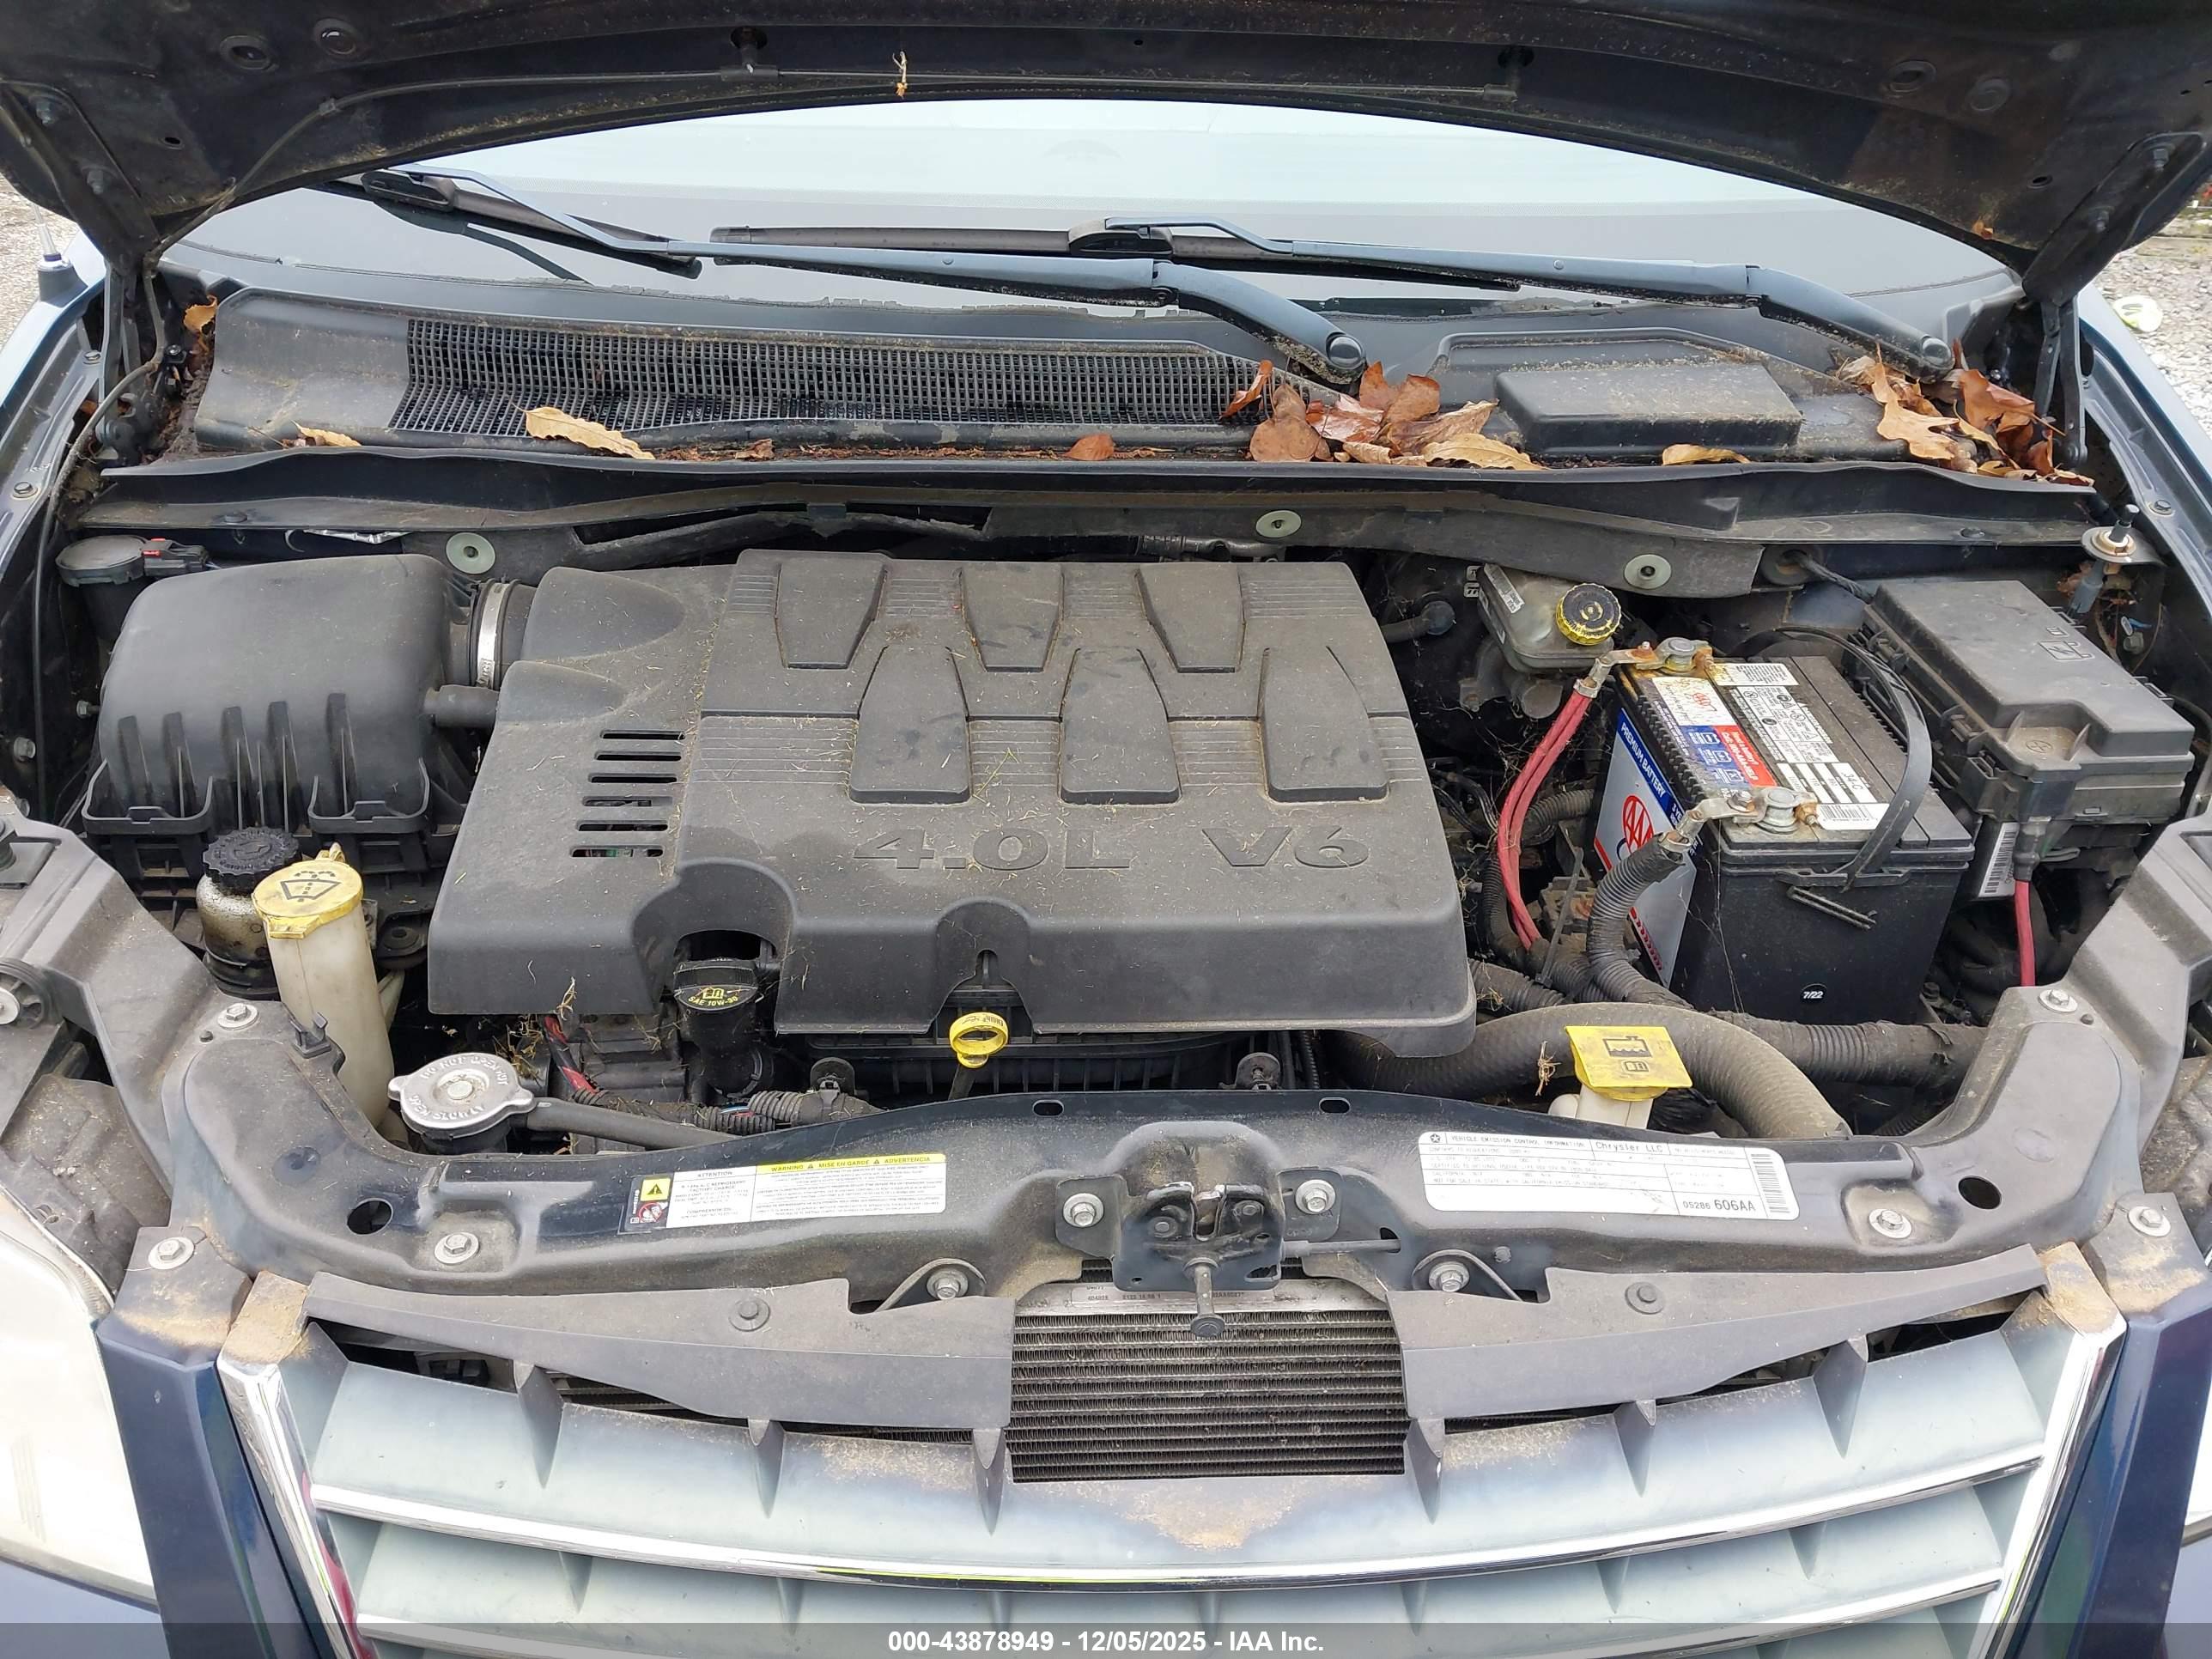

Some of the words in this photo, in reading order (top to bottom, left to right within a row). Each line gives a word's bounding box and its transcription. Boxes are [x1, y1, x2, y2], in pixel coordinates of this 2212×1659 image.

[1620, 721, 1644, 763] PREMIUM
[1641, 757, 1667, 799] BATTERY
[853, 828, 1131, 870] 4.0L
[1201, 825, 1370, 868] V6
[688, 996, 706, 1006] SAE
[707, 995, 738, 1006] 10W-30
[420, 1066, 437, 1079] DO
[440, 1056, 466, 1069] NOT
[1595, 1141, 1639, 1152] Chrysler
[1682, 1201, 1711, 1210] 05286
[1714, 1199, 1756, 1212] 606AA
